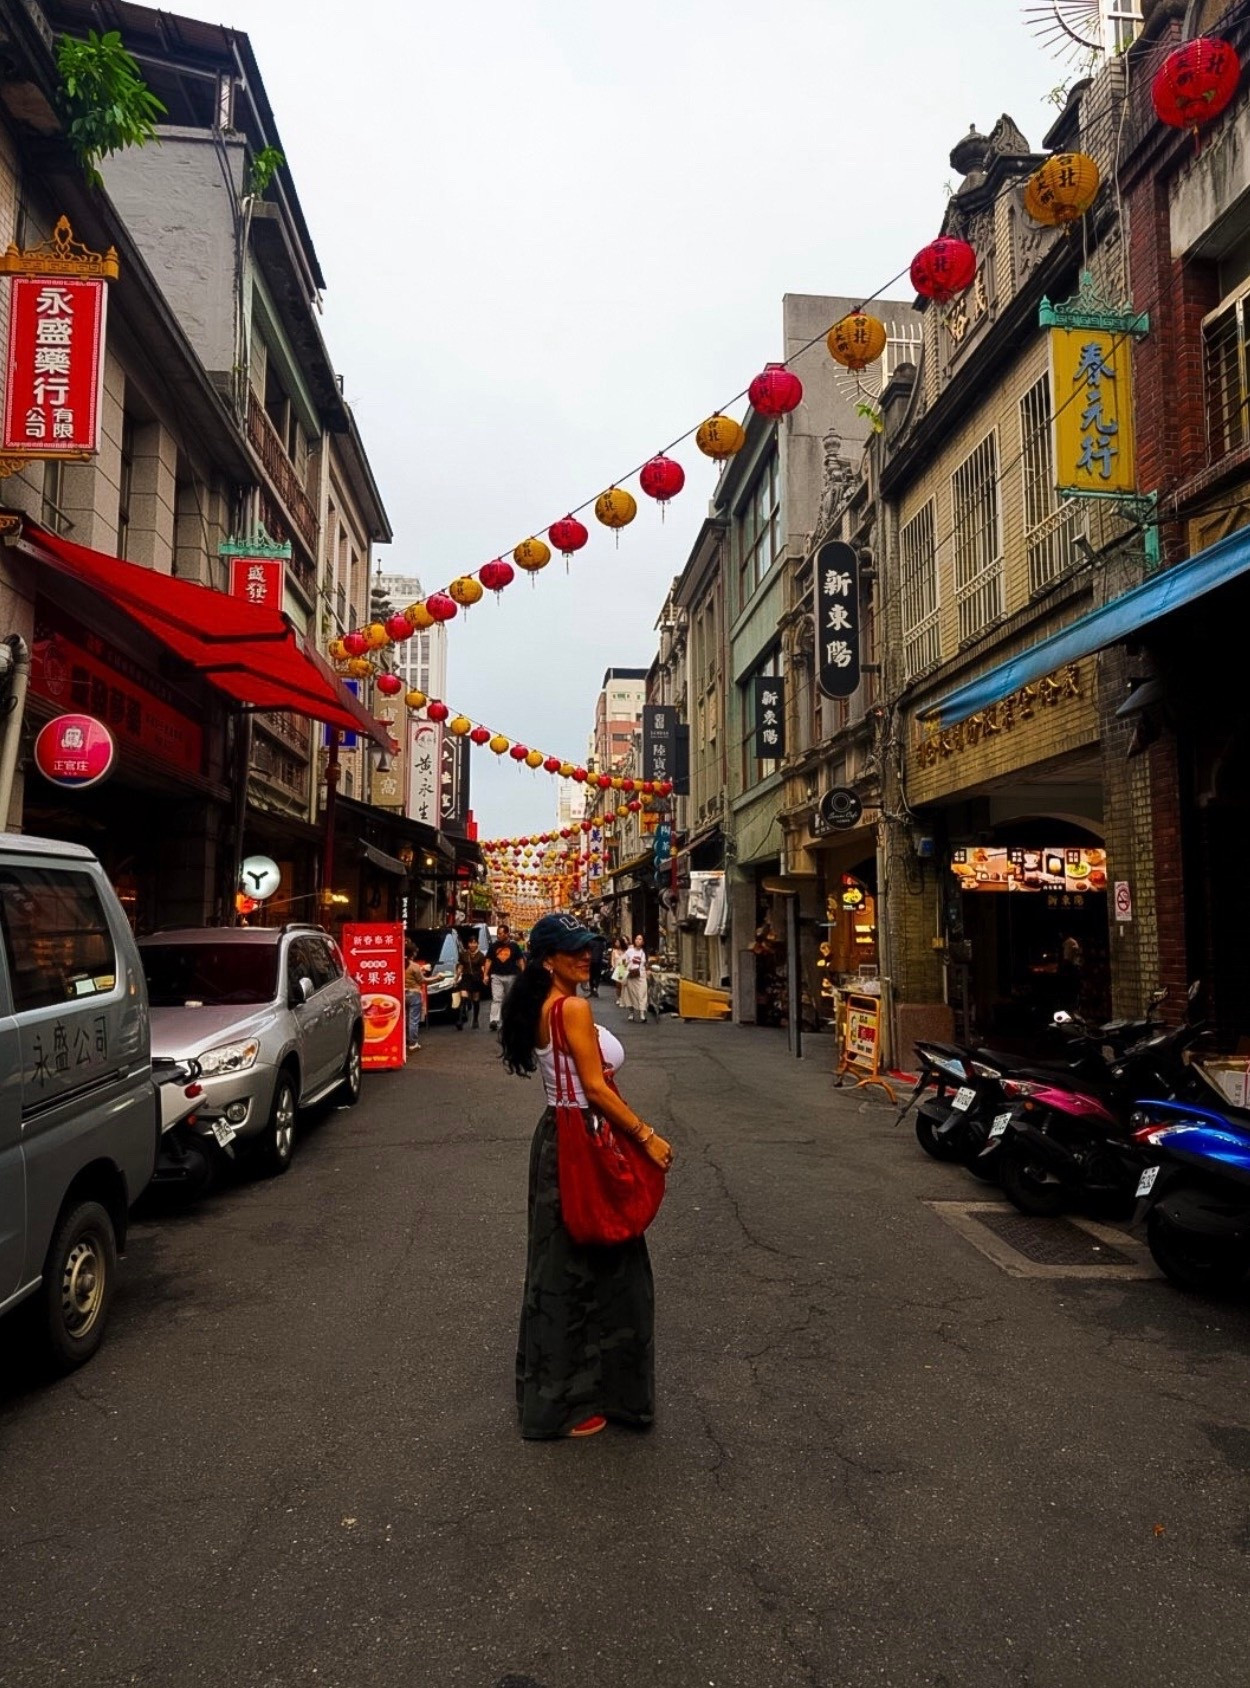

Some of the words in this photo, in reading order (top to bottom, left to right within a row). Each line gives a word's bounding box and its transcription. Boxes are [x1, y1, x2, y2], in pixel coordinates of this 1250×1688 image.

[33, 287, 74, 406] 永盛藥行
[25, 407, 46, 438] 公司
[53, 408, 74, 439] 有限
[823, 569, 854, 668] 新東陽
[761, 690, 779, 745] 新東陽
[32, 1015, 108, 1088] 永盛公司
